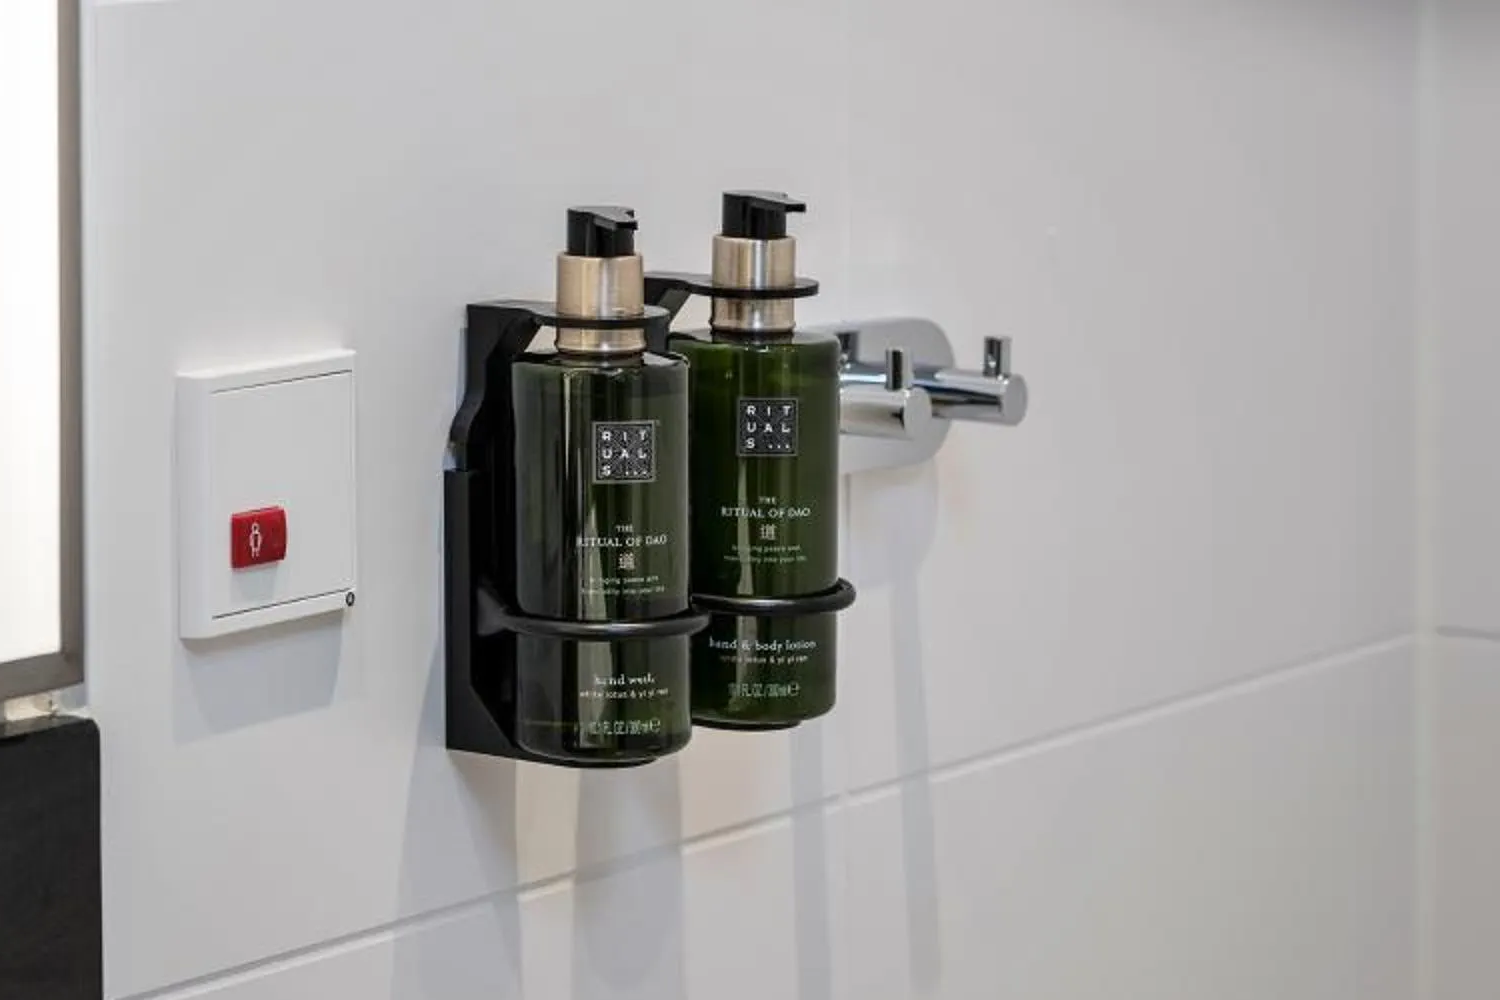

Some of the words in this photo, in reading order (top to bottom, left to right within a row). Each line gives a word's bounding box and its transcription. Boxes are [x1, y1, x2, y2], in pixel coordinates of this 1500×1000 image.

[721, 506, 765, 518] RITUAL
[767, 507, 784, 518] OF
[787, 507, 811, 517] DAO
[615, 524, 634, 533] THE
[576, 536, 623, 547] RITUAL
[625, 536, 642, 547] OF
[645, 534, 667, 545] DAO
[755, 640, 782, 652] body
[785, 639, 817, 651] lotion
